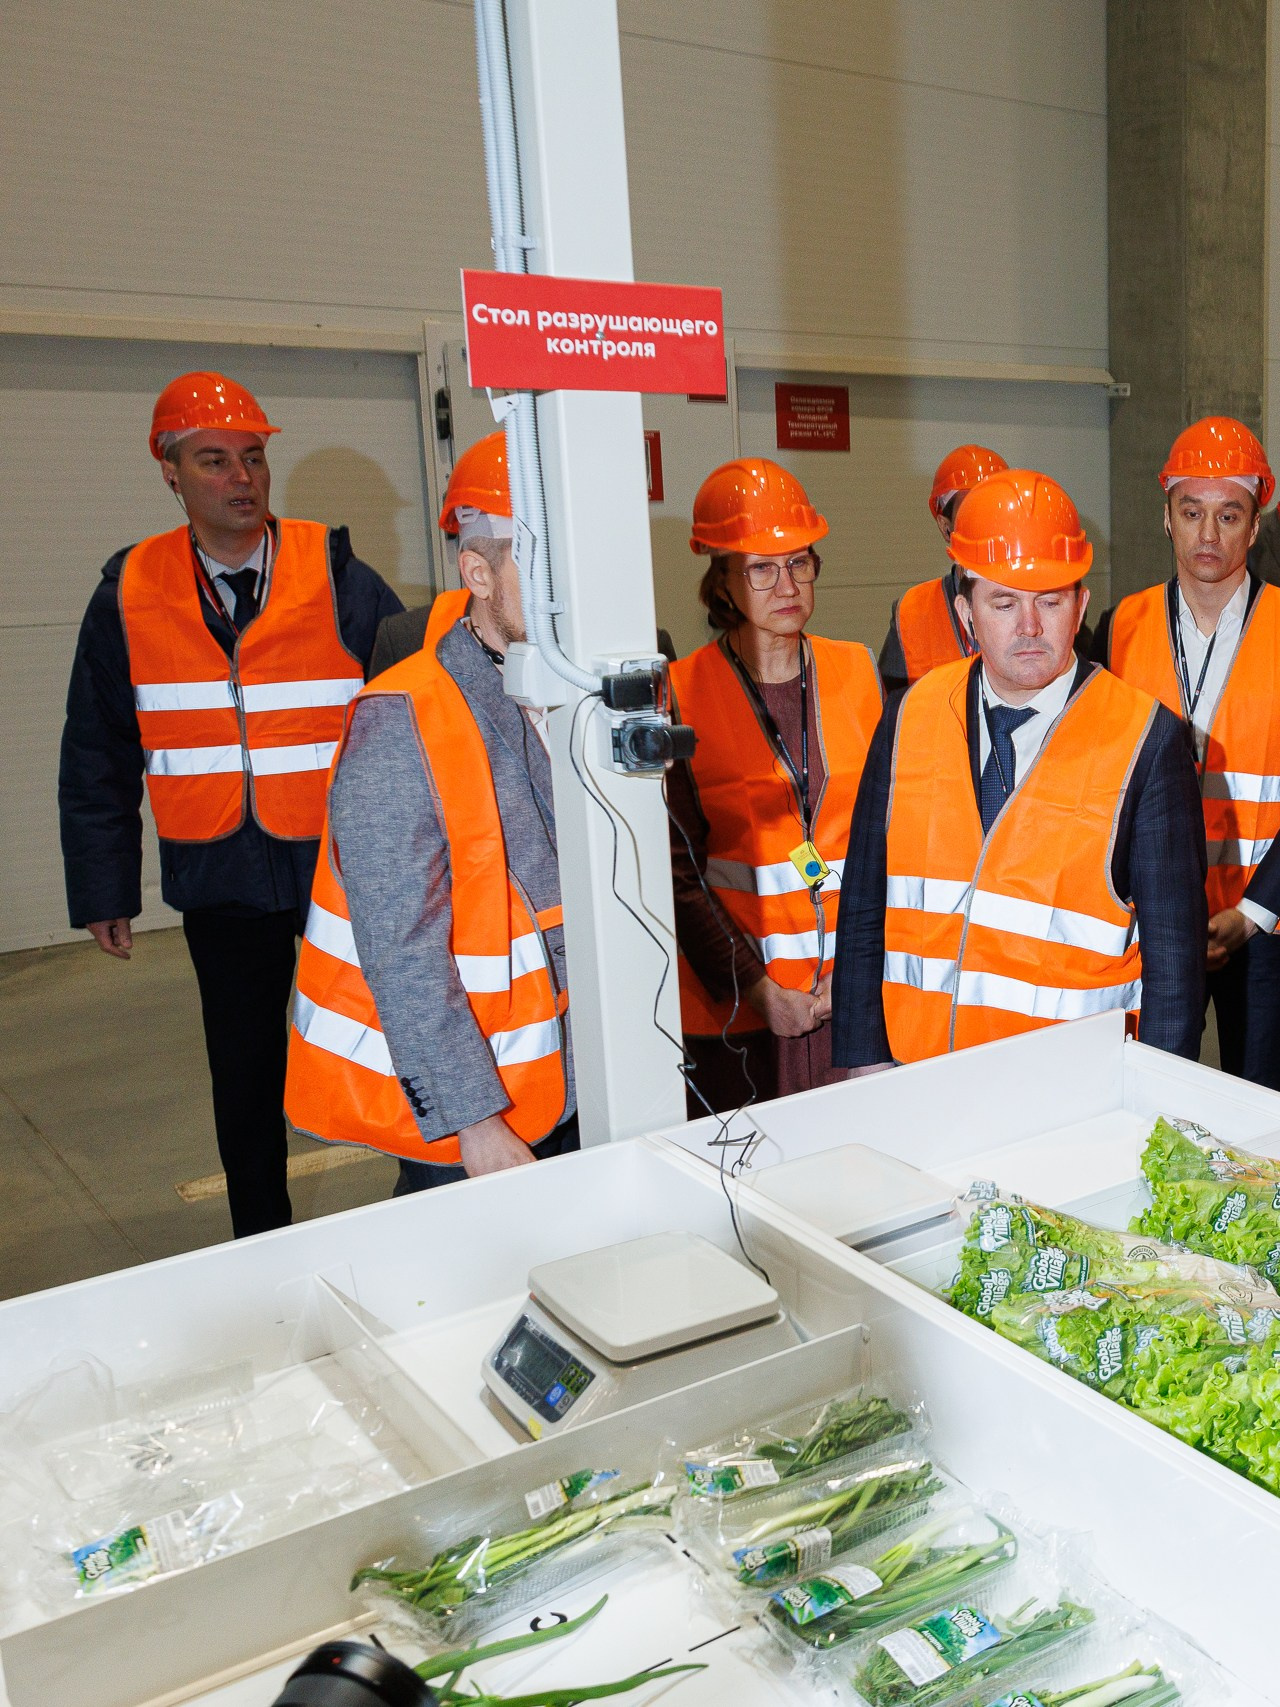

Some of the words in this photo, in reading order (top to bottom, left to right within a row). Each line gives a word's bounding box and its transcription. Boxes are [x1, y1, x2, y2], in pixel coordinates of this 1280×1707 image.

[472, 303, 530, 326] Стол
[537, 310, 718, 337] разрушающего
[546, 337, 656, 360] контроля
[994, 1206, 1010, 1247] Village
[1033, 1246, 1053, 1290] Global
[1046, 1247, 1066, 1288] Village
[977, 1271, 998, 1315] Global
[1099, 1330, 1111, 1381] Global
[1108, 1327, 1122, 1375] Village
